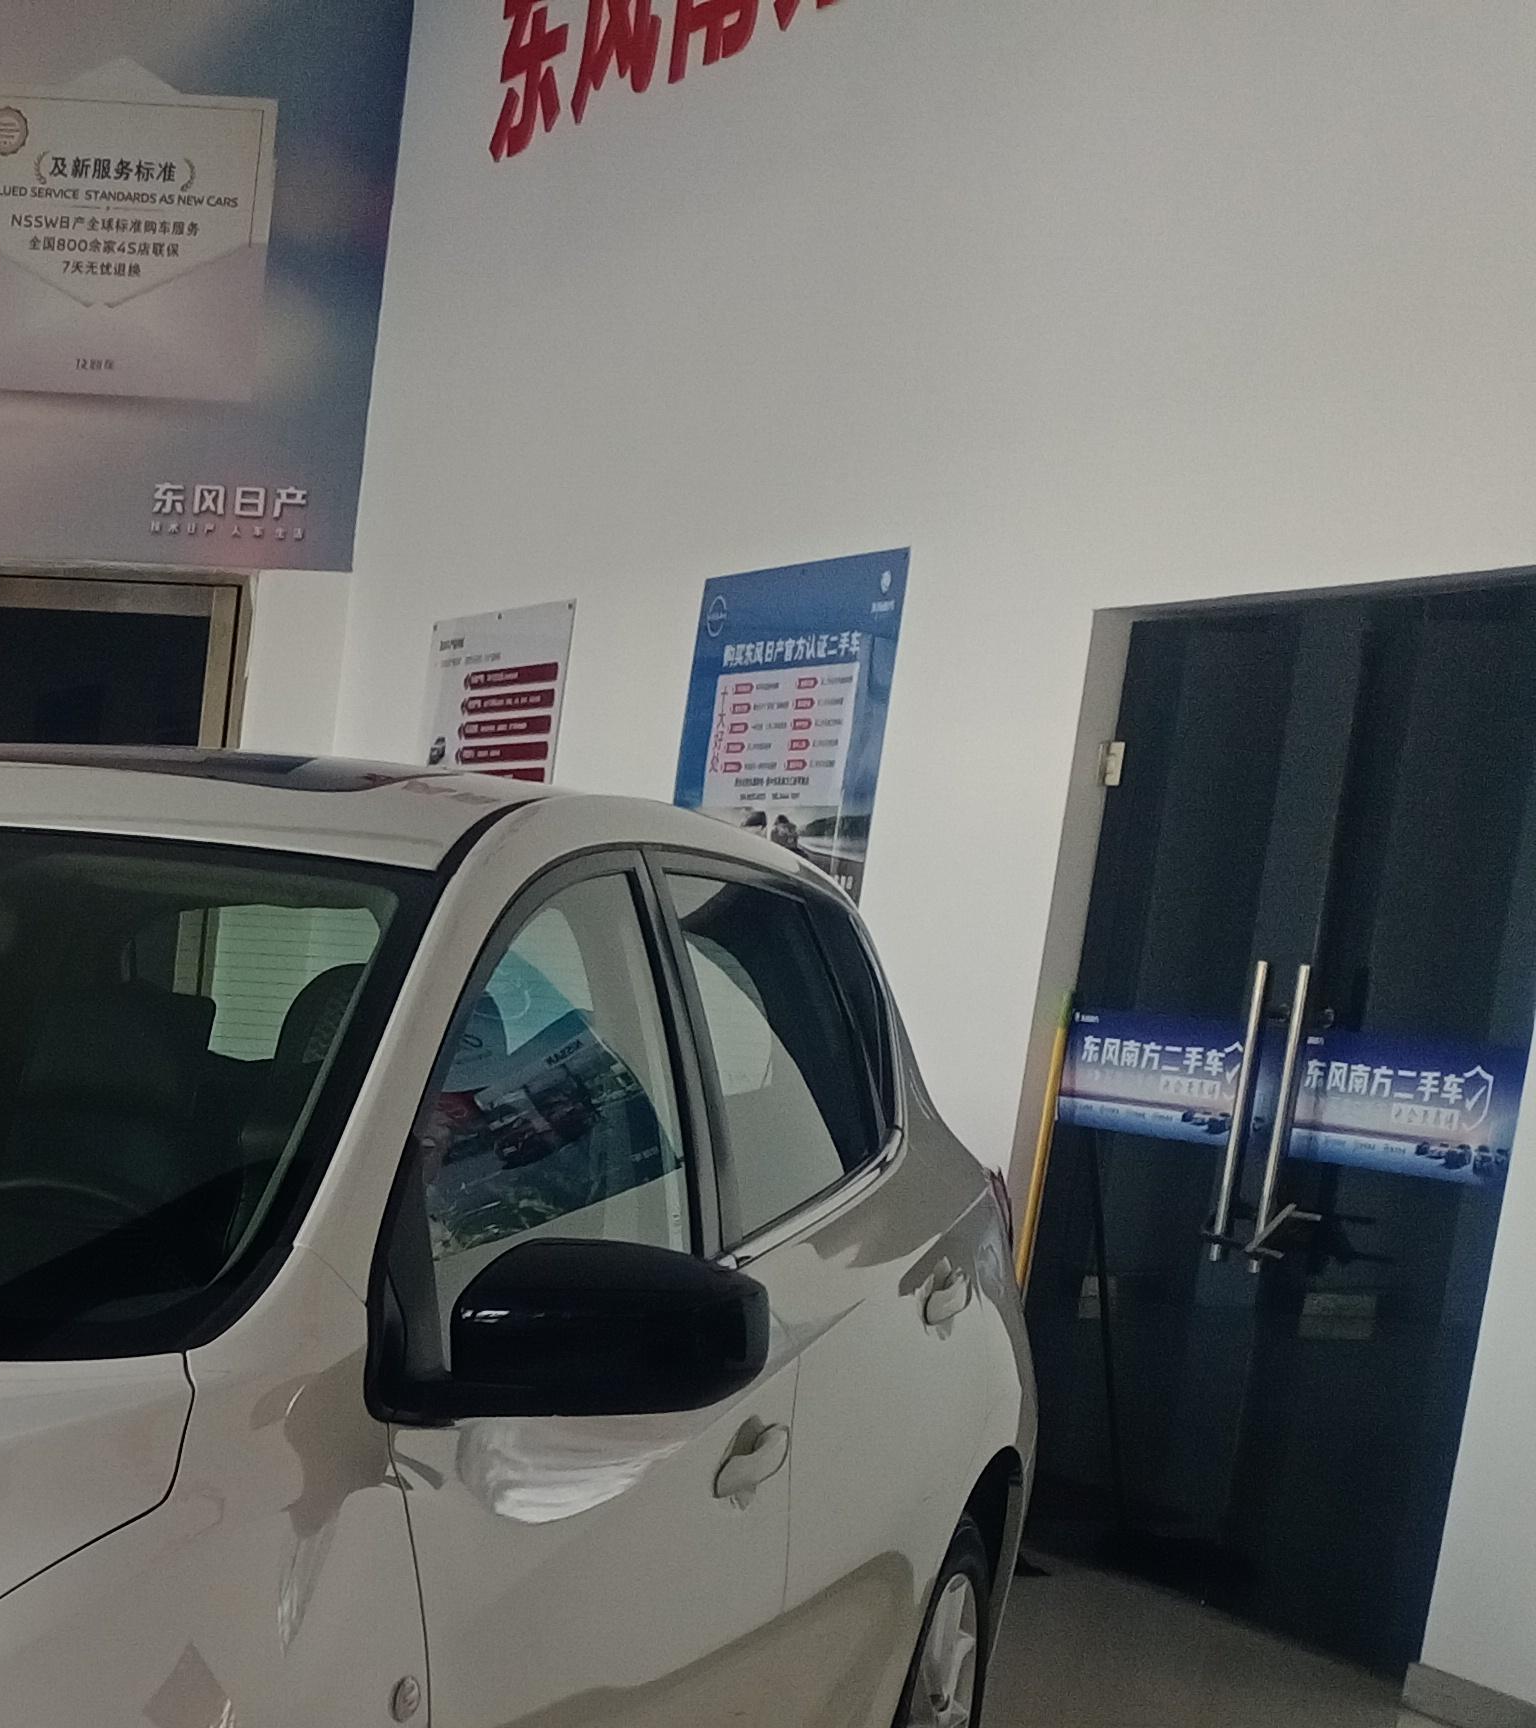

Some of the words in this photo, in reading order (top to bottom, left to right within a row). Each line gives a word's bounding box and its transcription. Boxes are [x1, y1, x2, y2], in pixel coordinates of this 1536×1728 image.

[489, 0, 840, 162] 东风
[49, 156, 177, 183] 及新服务标准
[30, 187, 79, 200] SERVICE
[84, 189, 157, 205] STANDARDS
[158, 193, 176, 206] AS
[177, 195, 205, 207] NEW
[206, 195, 239, 208] CARS
[152, 482, 308, 520] 东风日产
[1081, 1035, 1227, 1077] 东风南方二手车
[1303, 1058, 1466, 1106] 东风南方二手车
